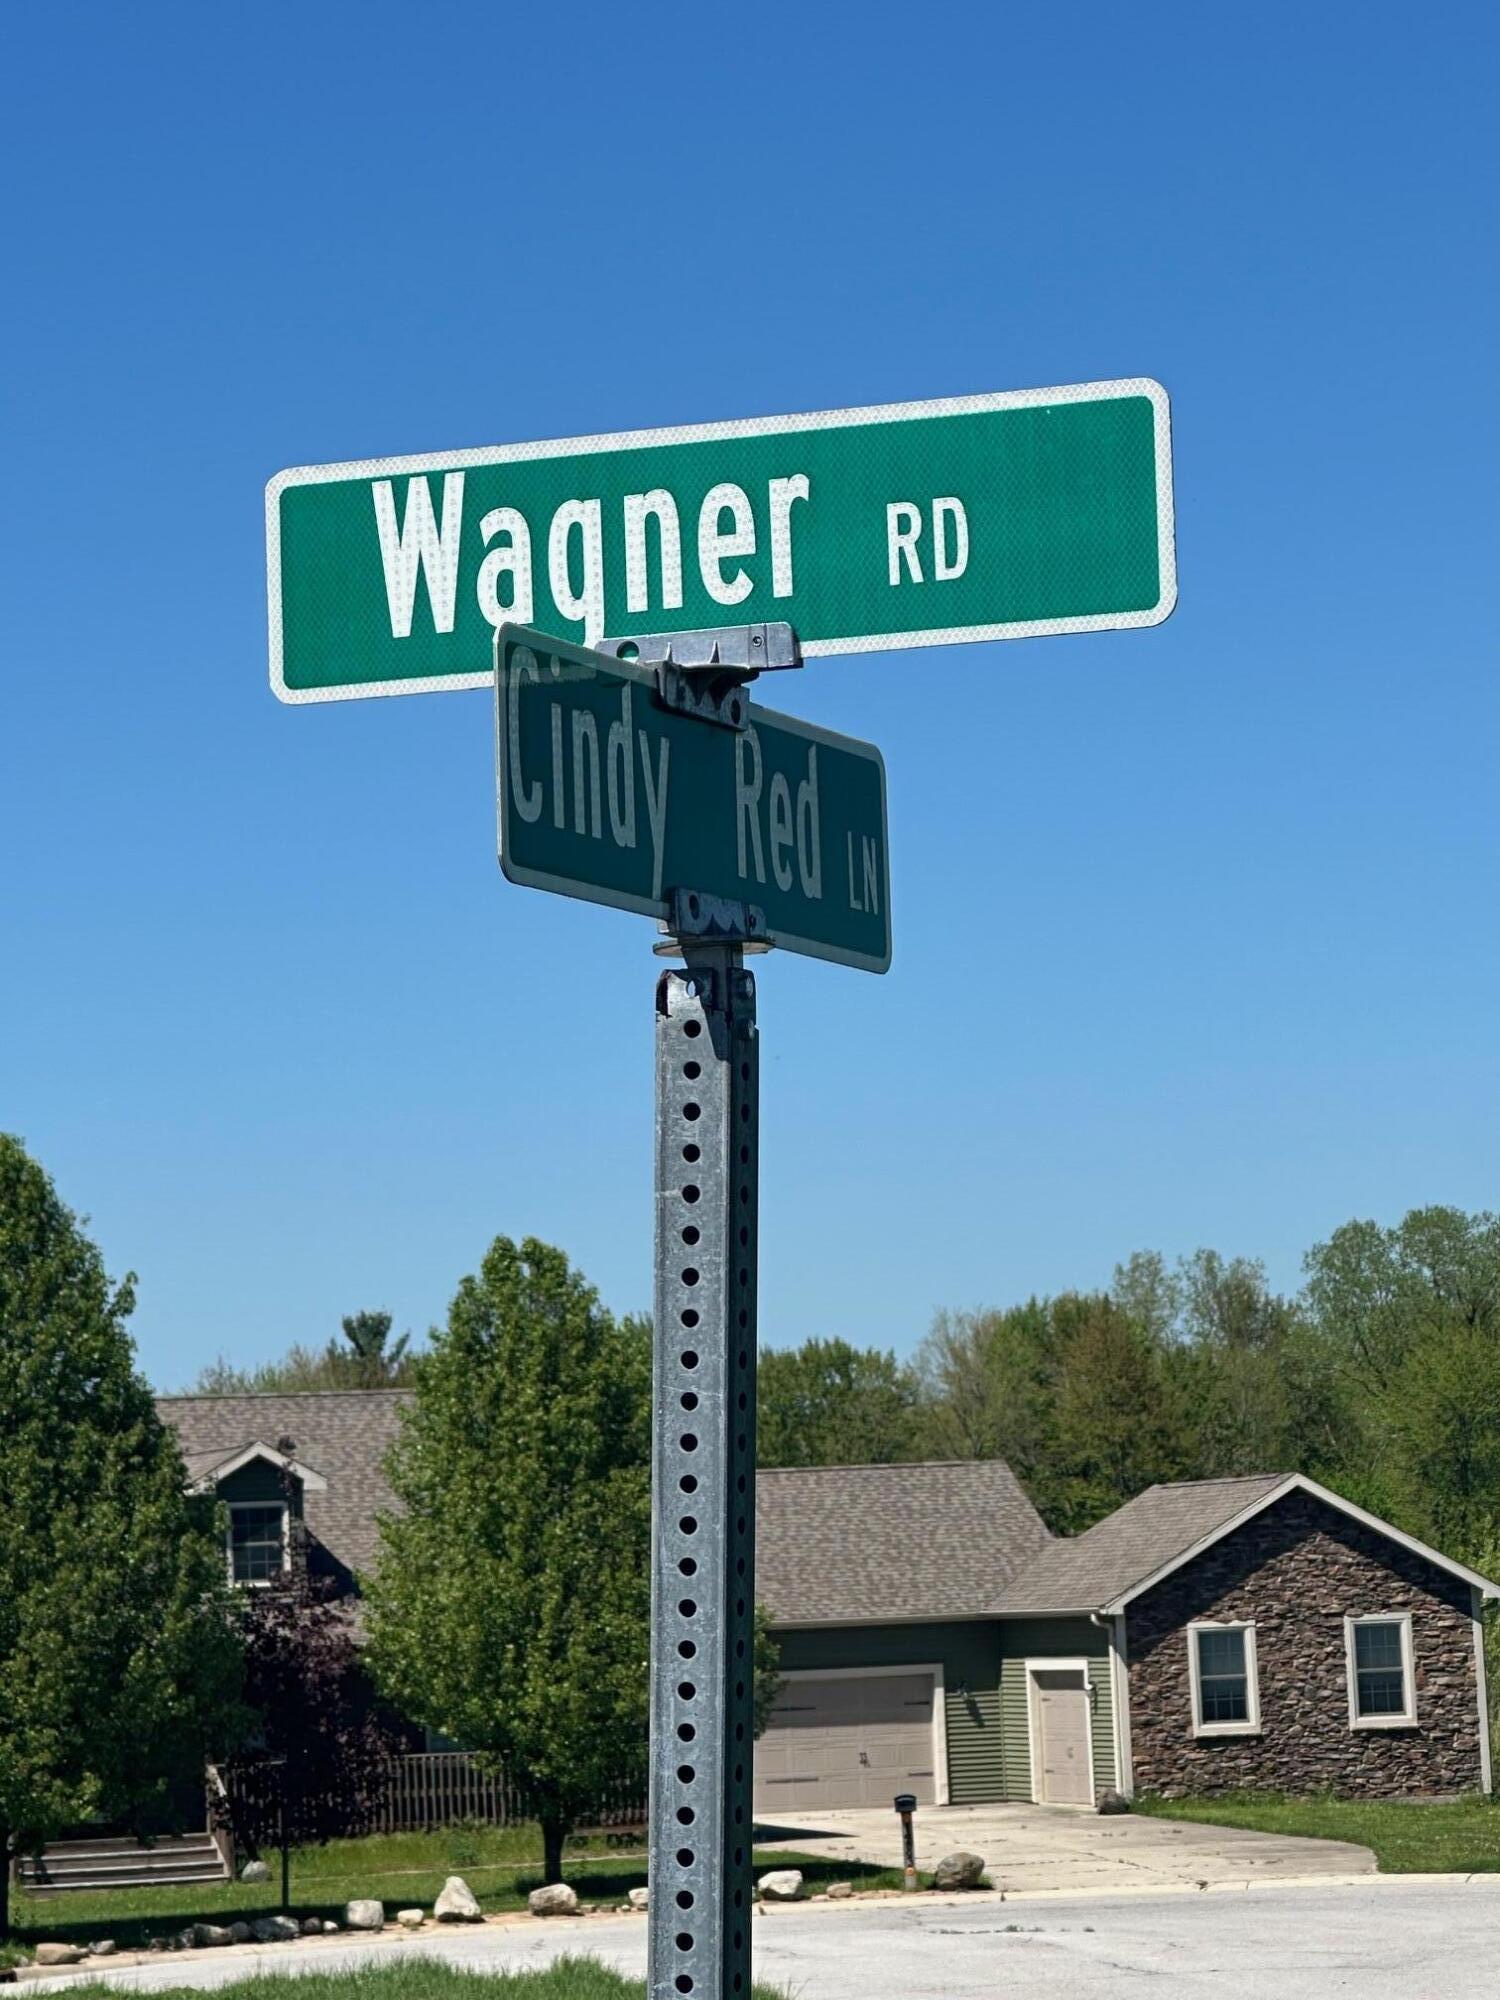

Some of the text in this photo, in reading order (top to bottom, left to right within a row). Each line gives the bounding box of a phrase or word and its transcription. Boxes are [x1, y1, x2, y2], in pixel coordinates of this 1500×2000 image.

[371, 470, 969, 647] Wagner RD
[508, 645, 879, 915] Cindy Red LN
